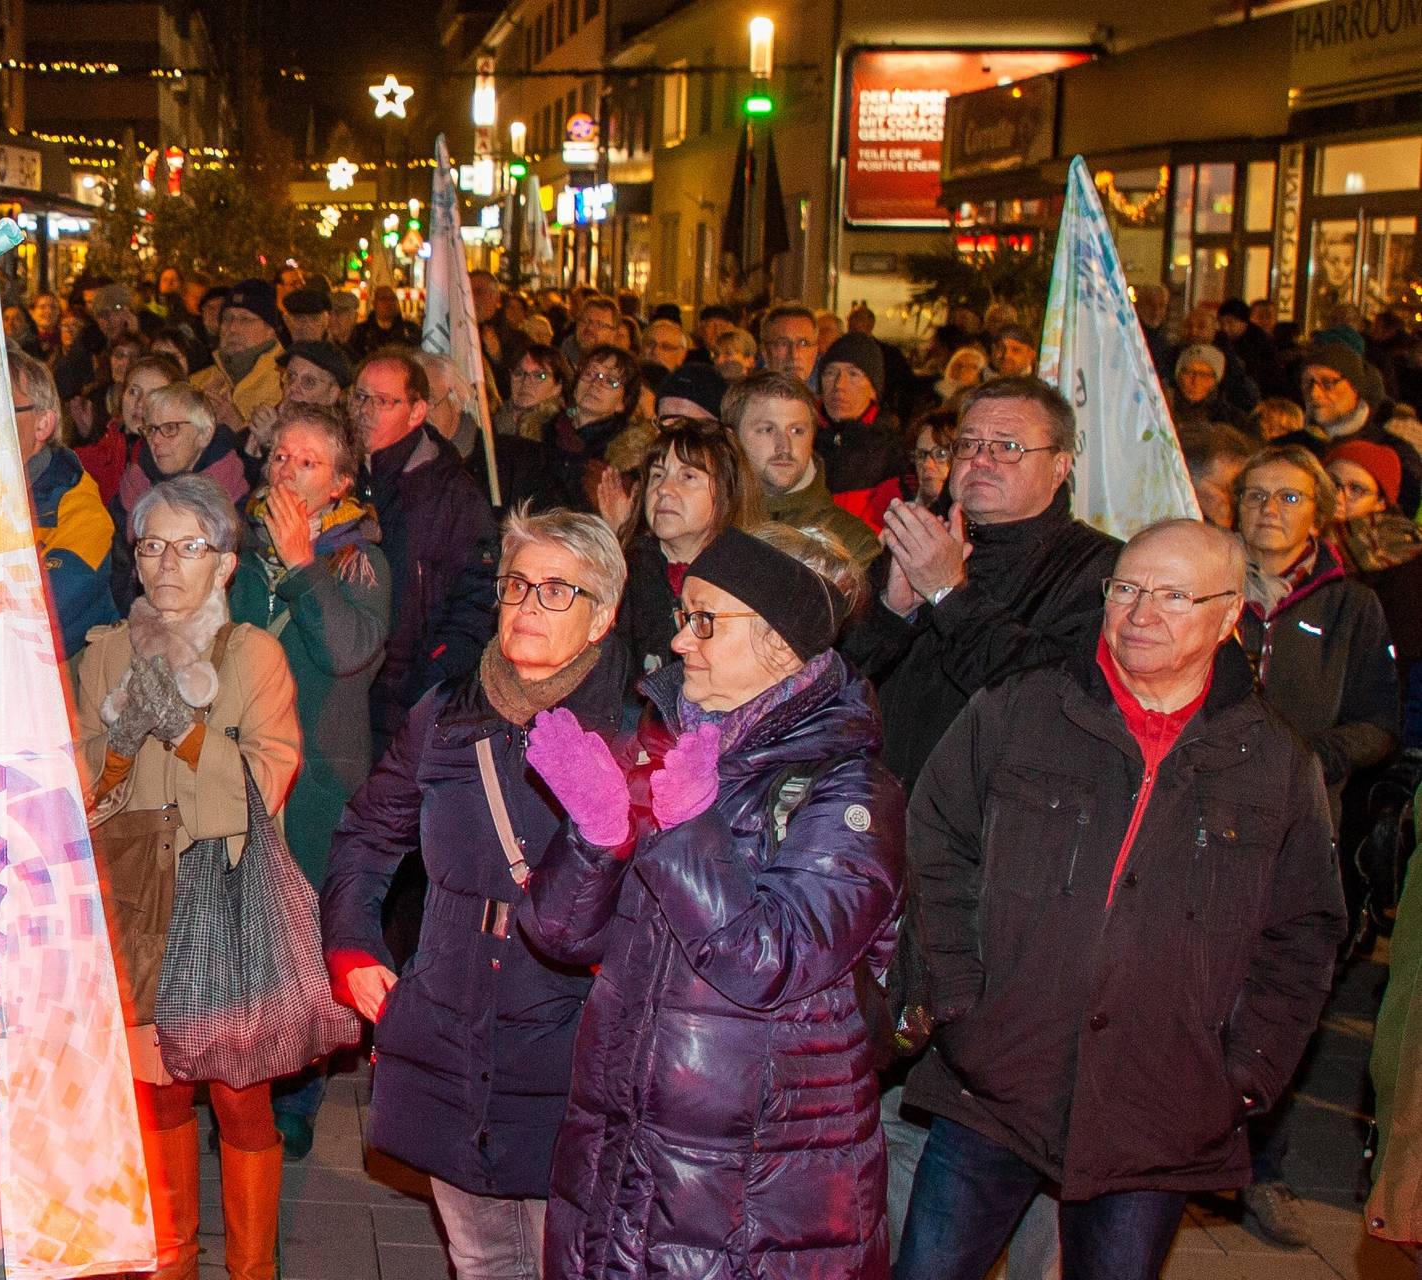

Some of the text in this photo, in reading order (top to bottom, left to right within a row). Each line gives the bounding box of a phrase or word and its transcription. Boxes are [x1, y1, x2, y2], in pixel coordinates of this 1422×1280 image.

[859, 90, 890, 104] DER
[919, 103, 945, 117] DRI
[859, 116, 885, 129] MIT
[859, 149, 922, 160] TEILE DEINE
[857, 160, 905, 172] POSITIVE
